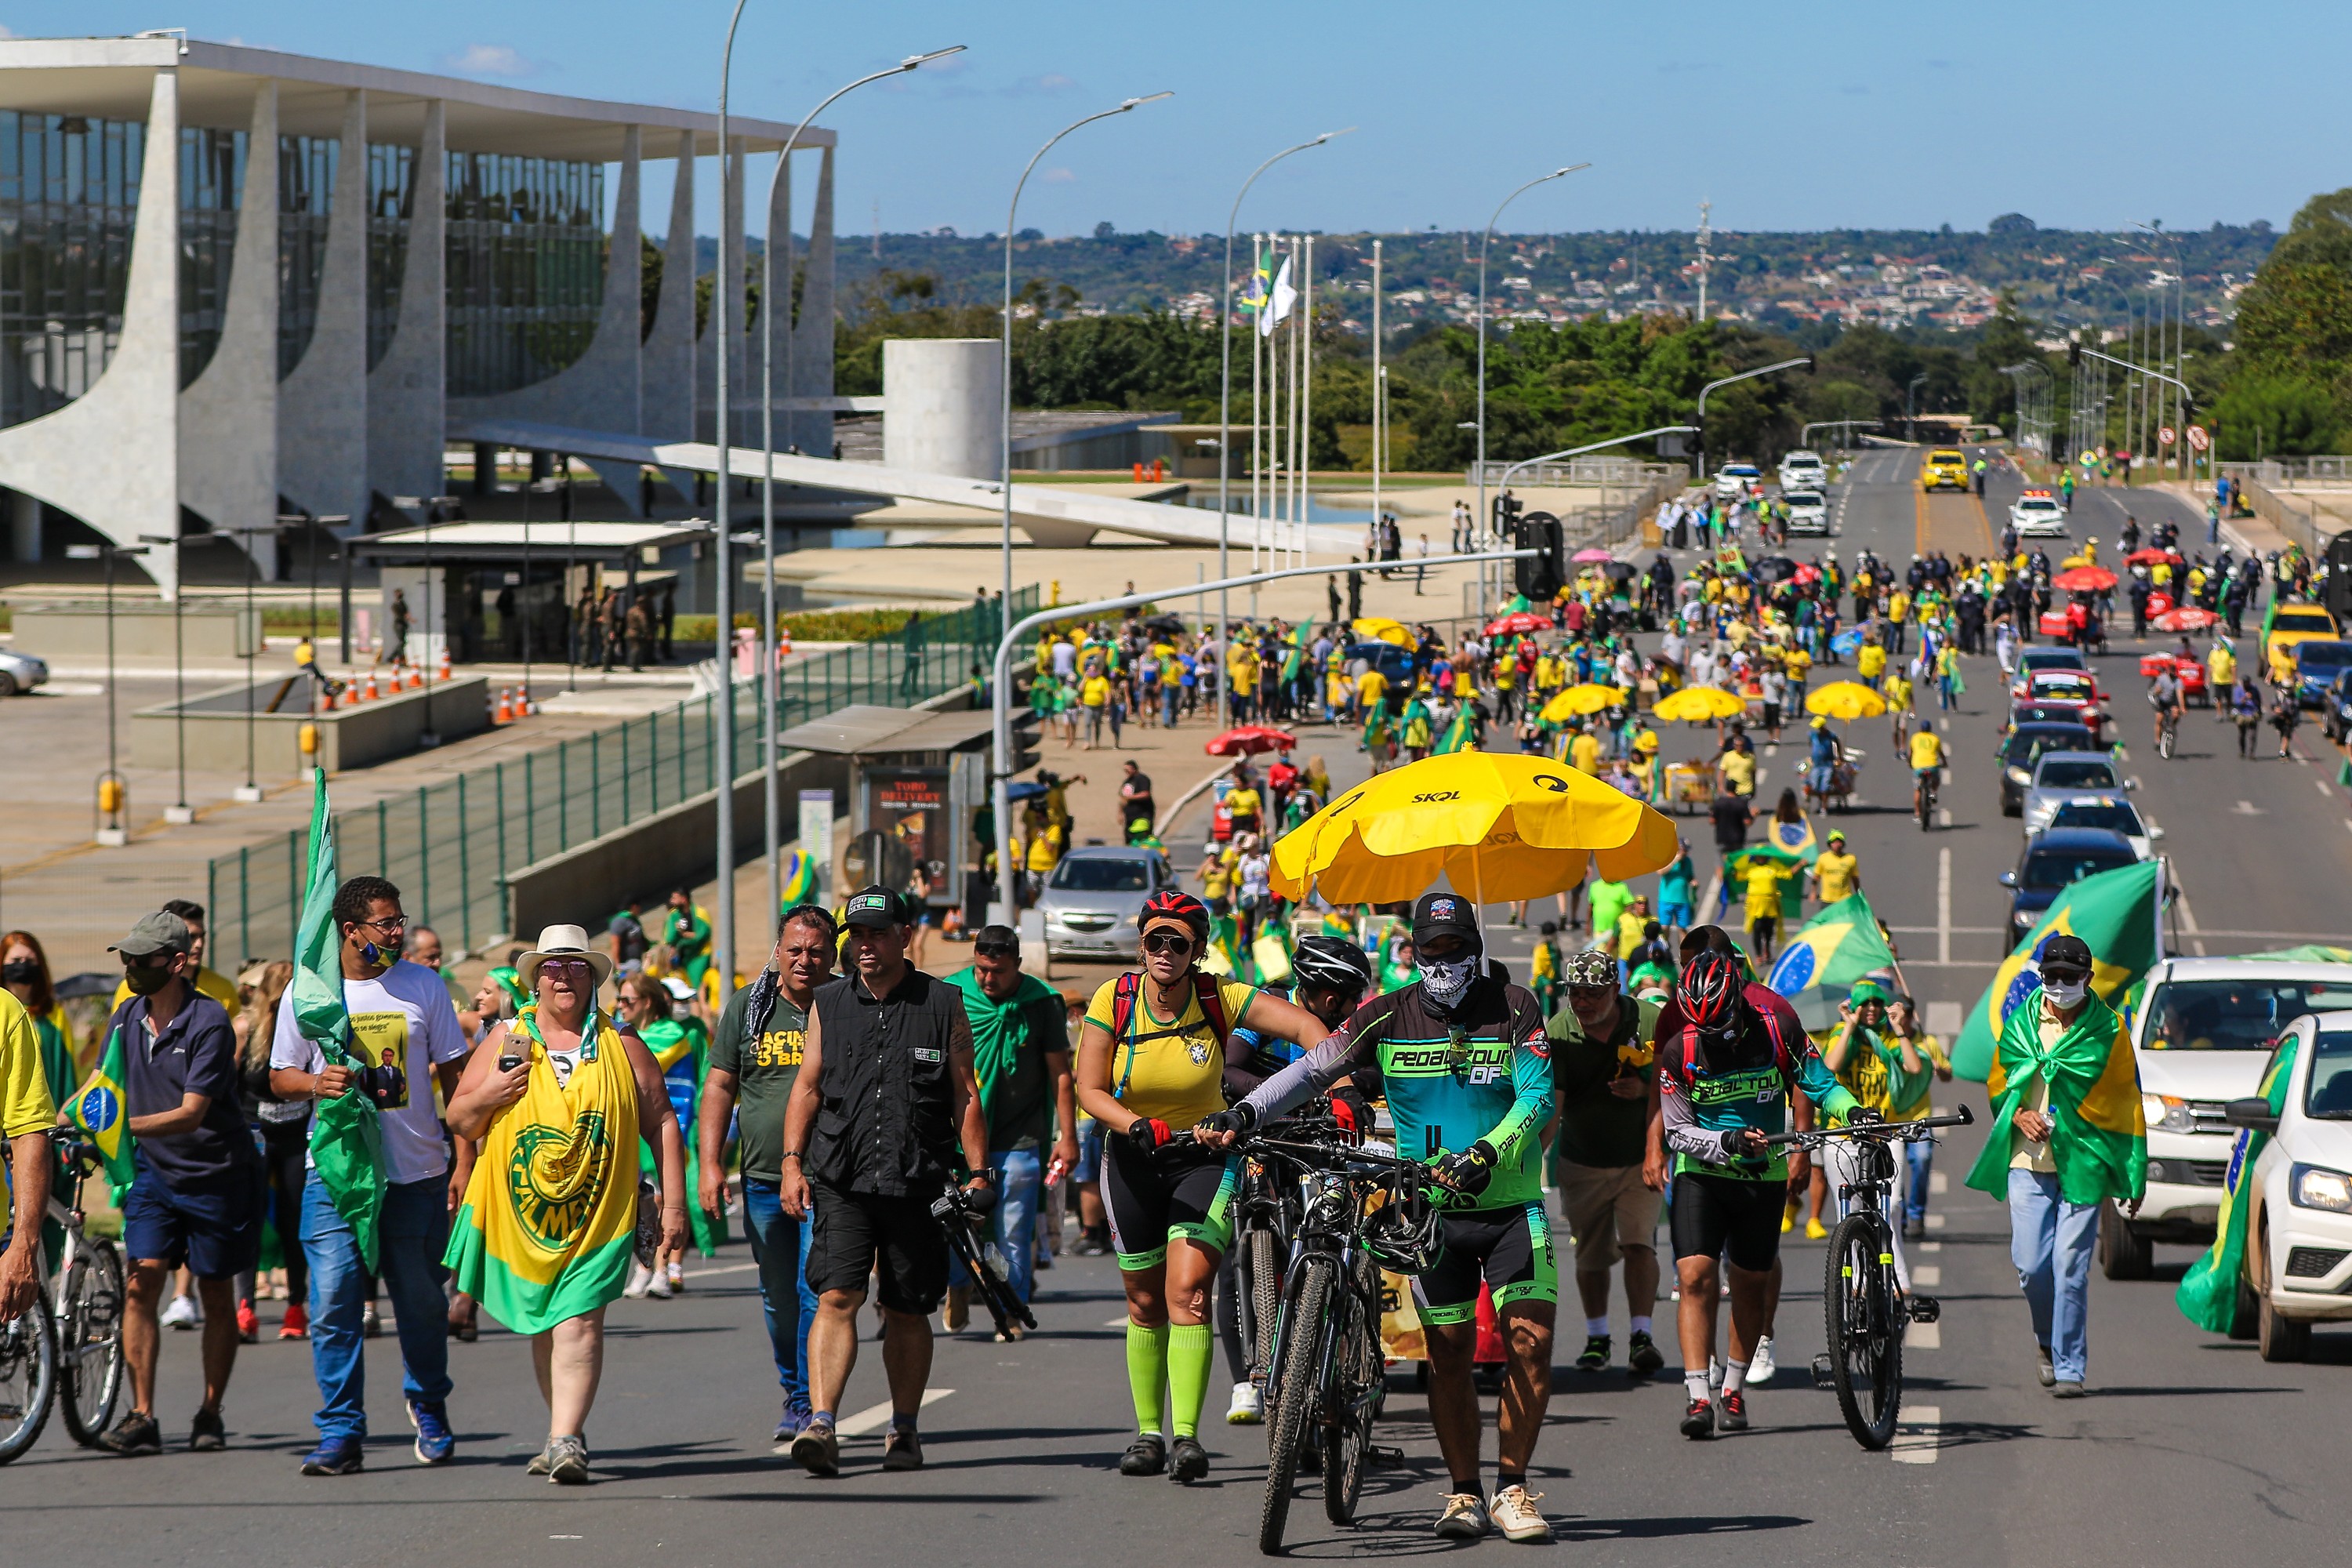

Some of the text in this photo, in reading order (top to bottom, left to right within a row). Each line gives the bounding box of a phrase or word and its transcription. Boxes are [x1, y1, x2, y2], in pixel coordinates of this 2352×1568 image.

[895, 782, 927, 791] TORO
[880, 792, 940, 801] DELIVERY
[1411, 790, 1461, 804] SKOL
[1468, 1065, 1503, 1085] DF
